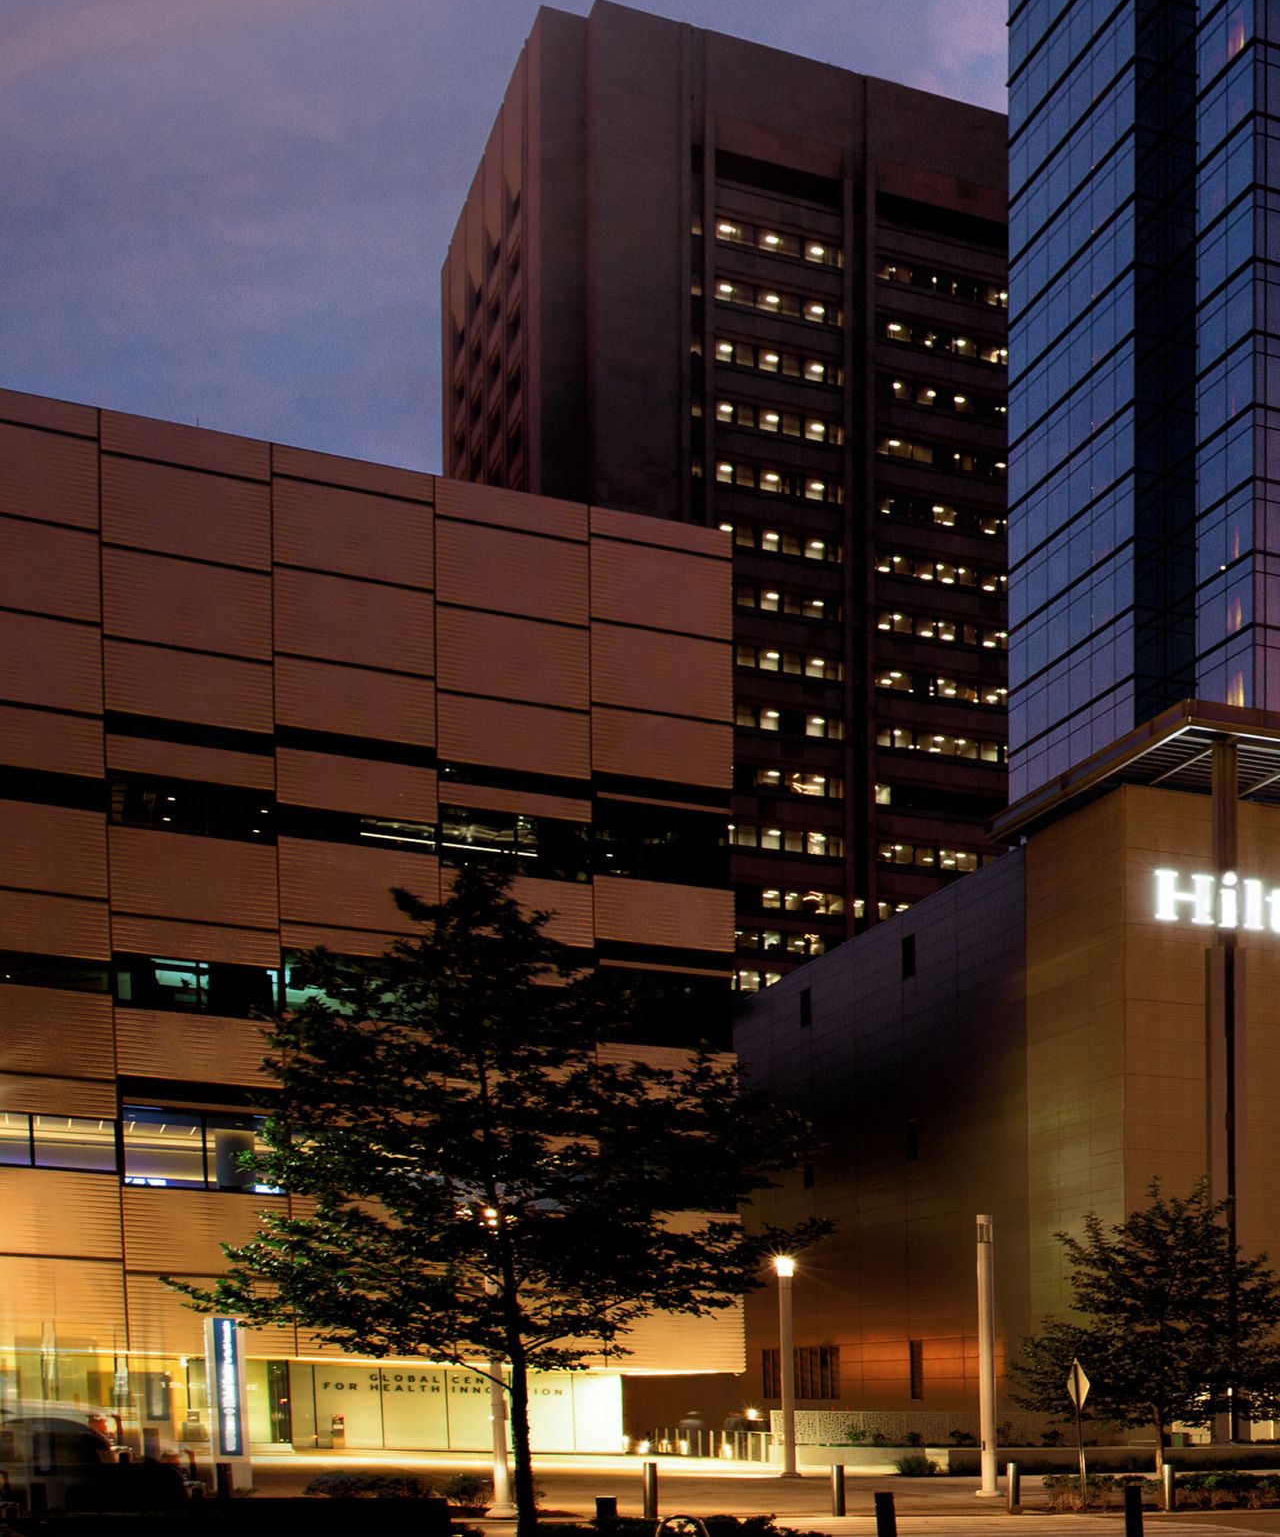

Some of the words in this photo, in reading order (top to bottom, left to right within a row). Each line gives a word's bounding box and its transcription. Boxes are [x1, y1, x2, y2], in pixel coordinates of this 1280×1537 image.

[369, 1373, 440, 1383] GLOBAL
[323, 1381, 358, 1390] FOR
[369, 1383, 441, 1392] HEALTH
[451, 1386, 563, 1396] INNOION
